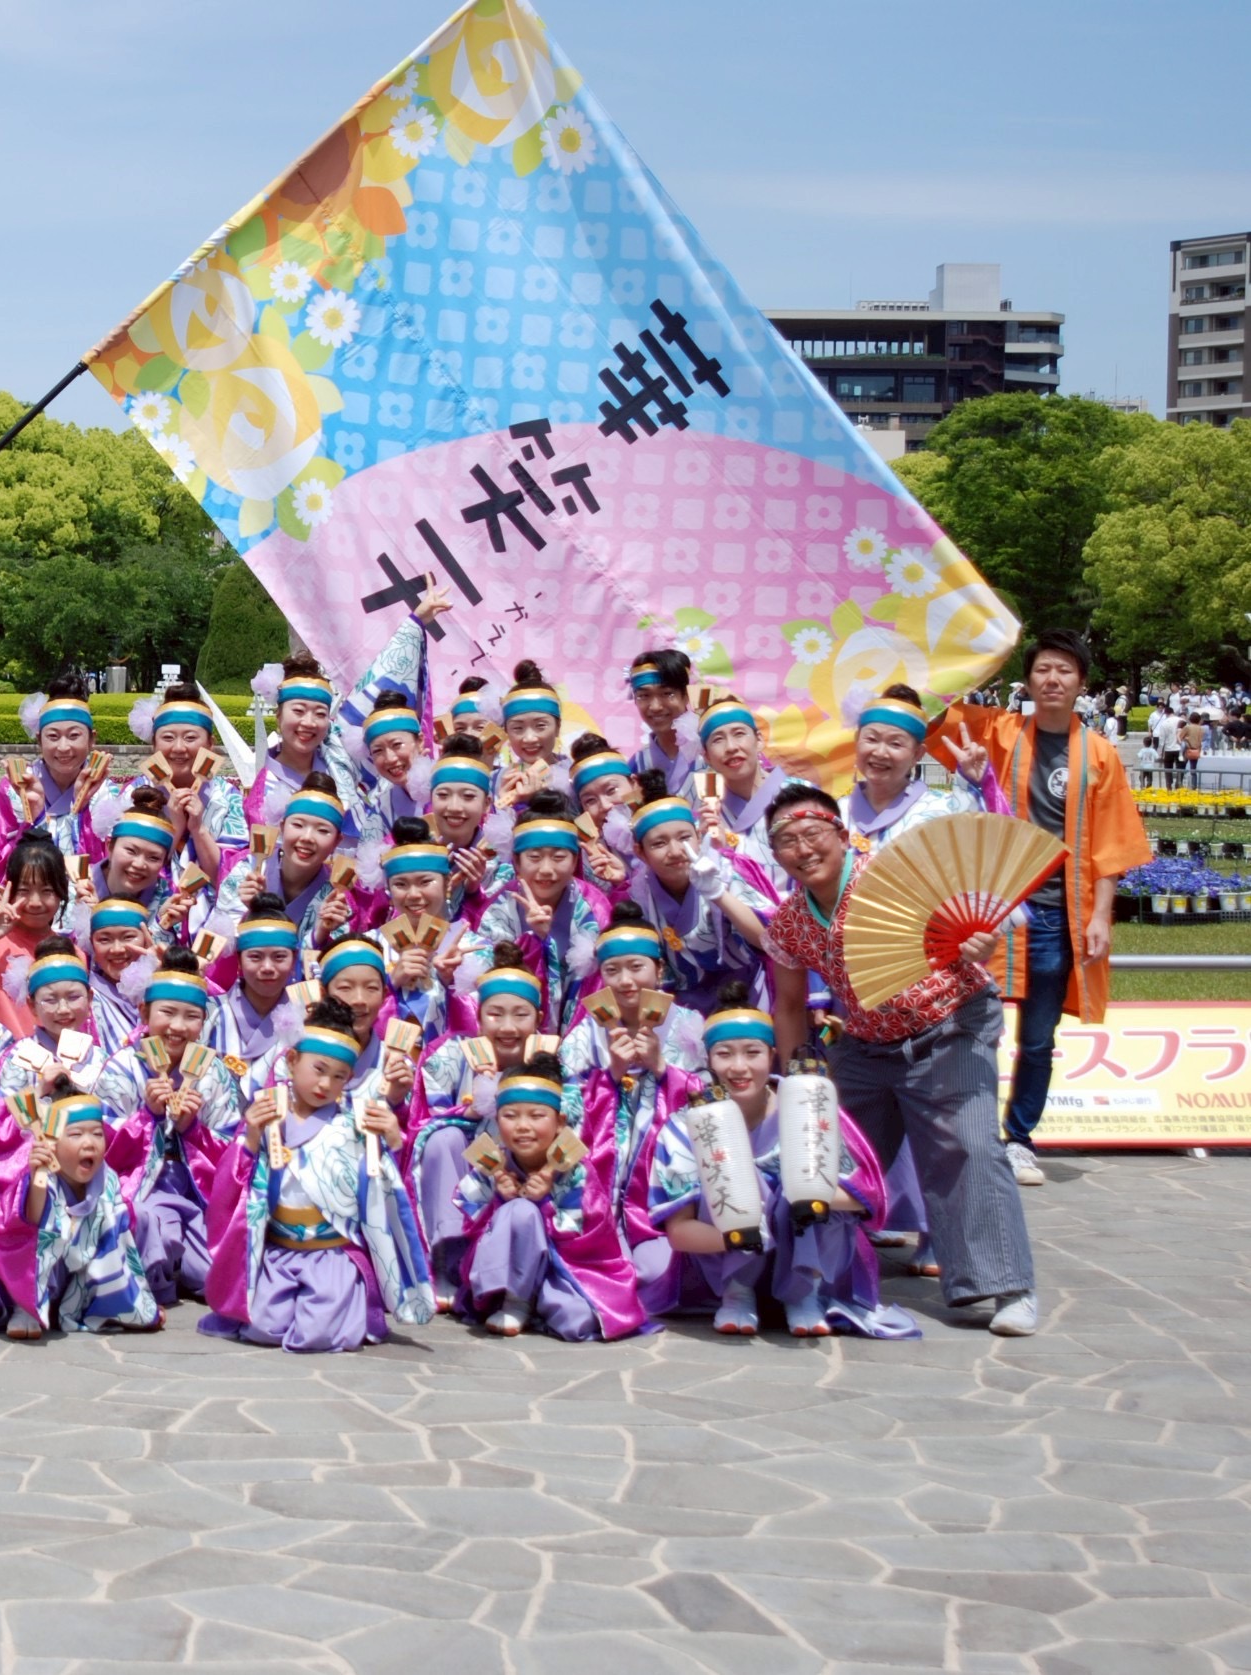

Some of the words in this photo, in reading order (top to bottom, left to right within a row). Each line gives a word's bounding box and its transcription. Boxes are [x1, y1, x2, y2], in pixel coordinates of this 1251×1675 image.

[361, 298, 730, 643] 華笑天
[1176, 1092, 1251, 1109] NOMU
[693, 1112, 748, 1218] 華笑天
